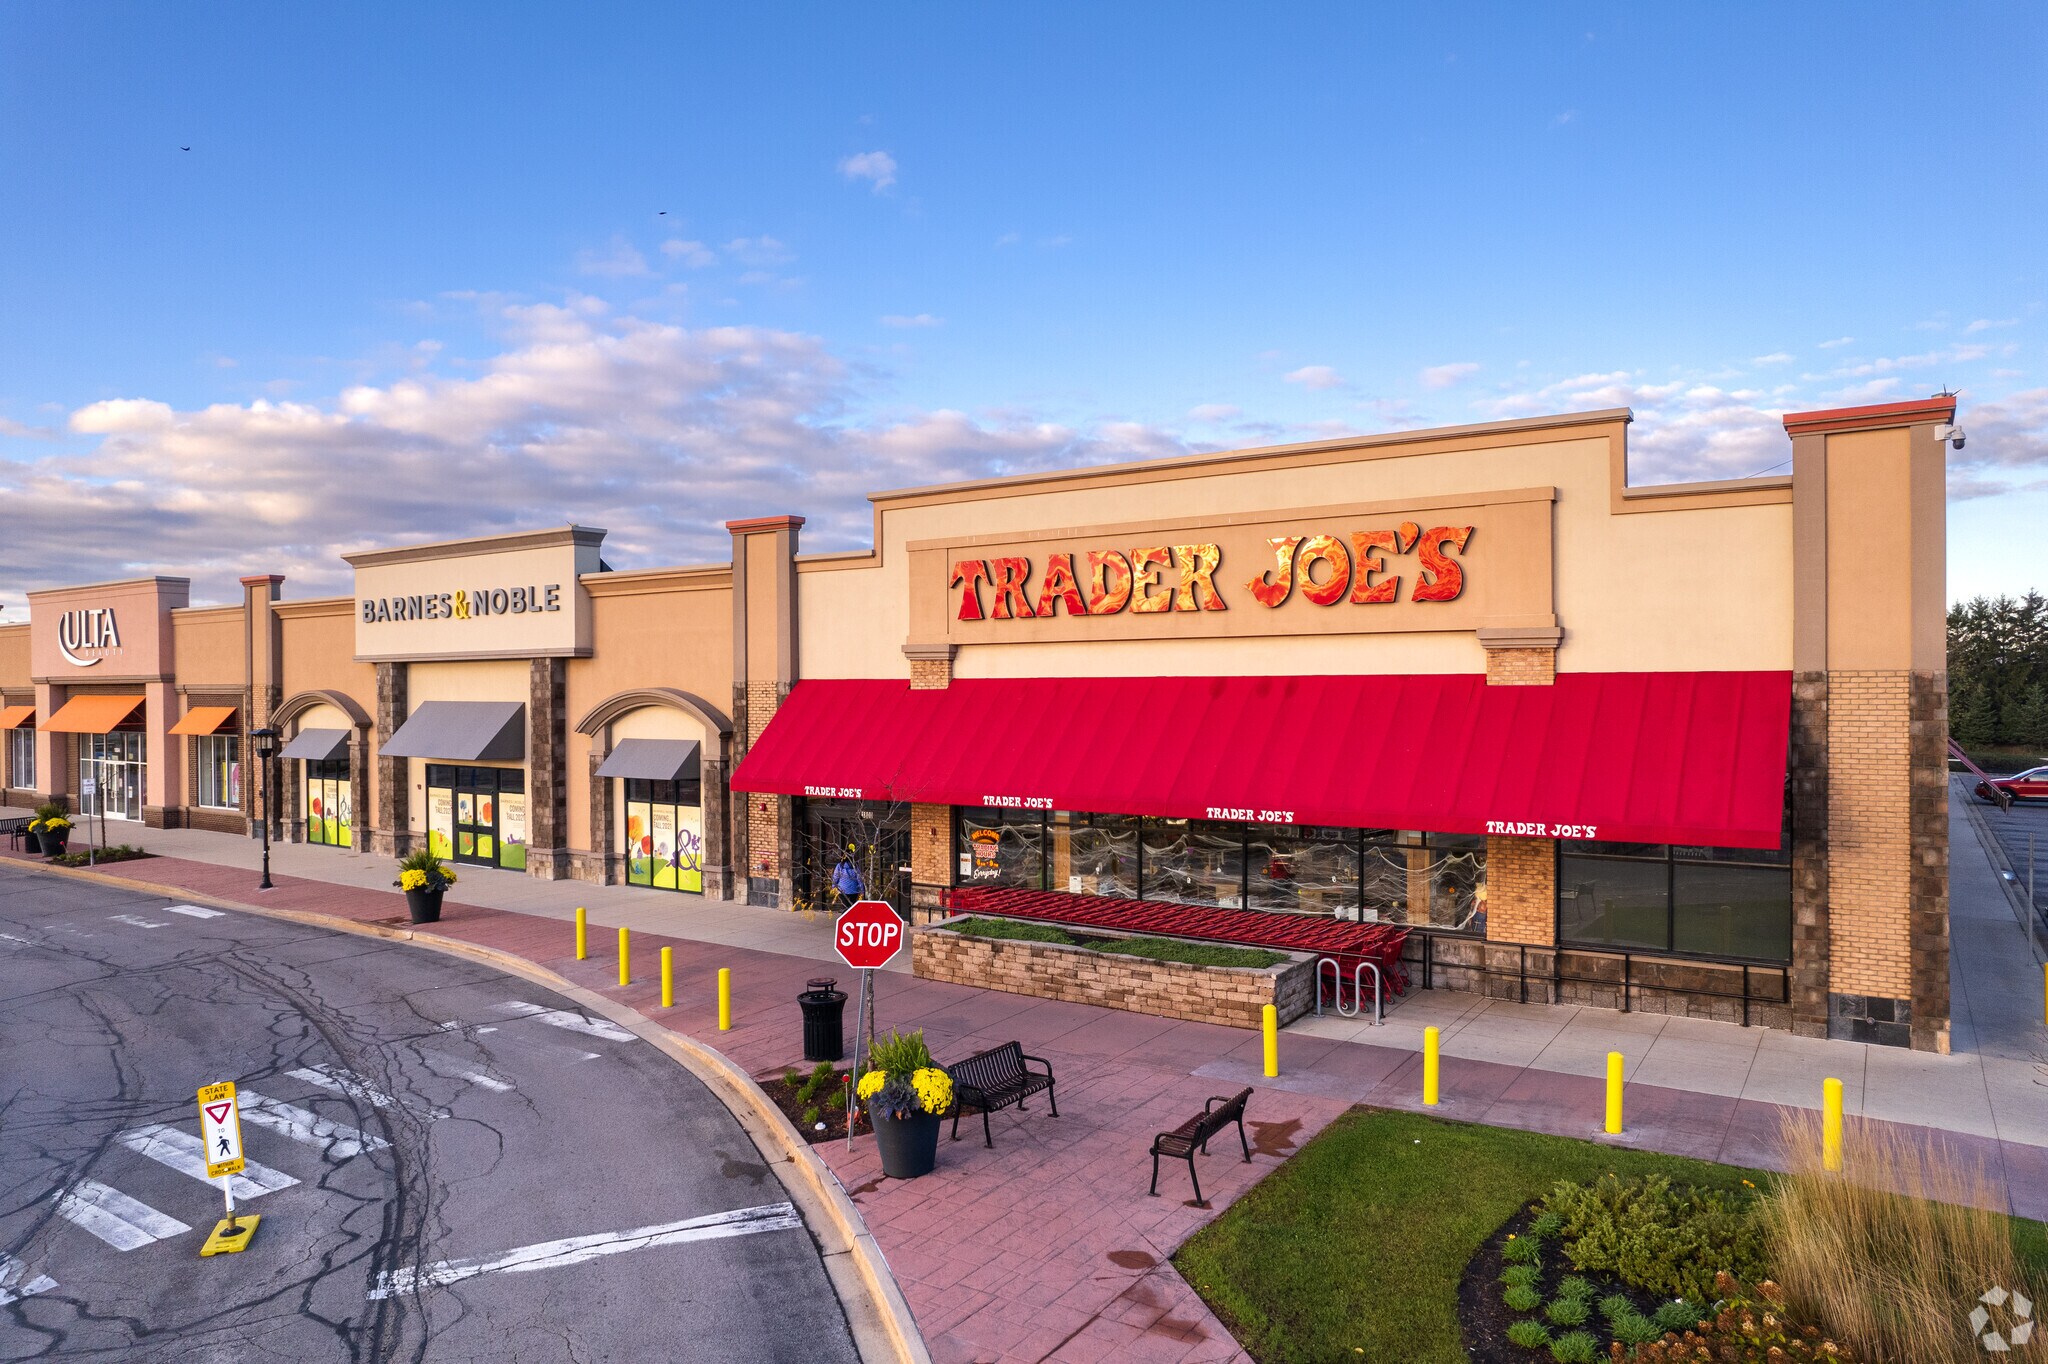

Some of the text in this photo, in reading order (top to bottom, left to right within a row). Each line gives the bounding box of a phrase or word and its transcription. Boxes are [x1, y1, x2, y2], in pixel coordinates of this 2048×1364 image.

[950, 521, 1474, 620] TRADER JOE'S
[64, 608, 121, 650] ULTA
[85, 648, 124, 657] BEAUTY
[804, 786, 862, 798] TRADER JOE'S
[983, 795, 1053, 809] TRADER JOE'S
[1206, 807, 1294, 823] TRADER JOE'S
[971, 829, 1000, 840] WELCOME
[1486, 821, 1597, 838] TRADER JOE'S
[975, 850, 997, 859] HOURS
[840, 922, 899, 947] STOP
[204, 1085, 229, 1095] STATE
[209, 1093, 226, 1102] LAW
[211, 1165, 241, 1176] CROSWALK
